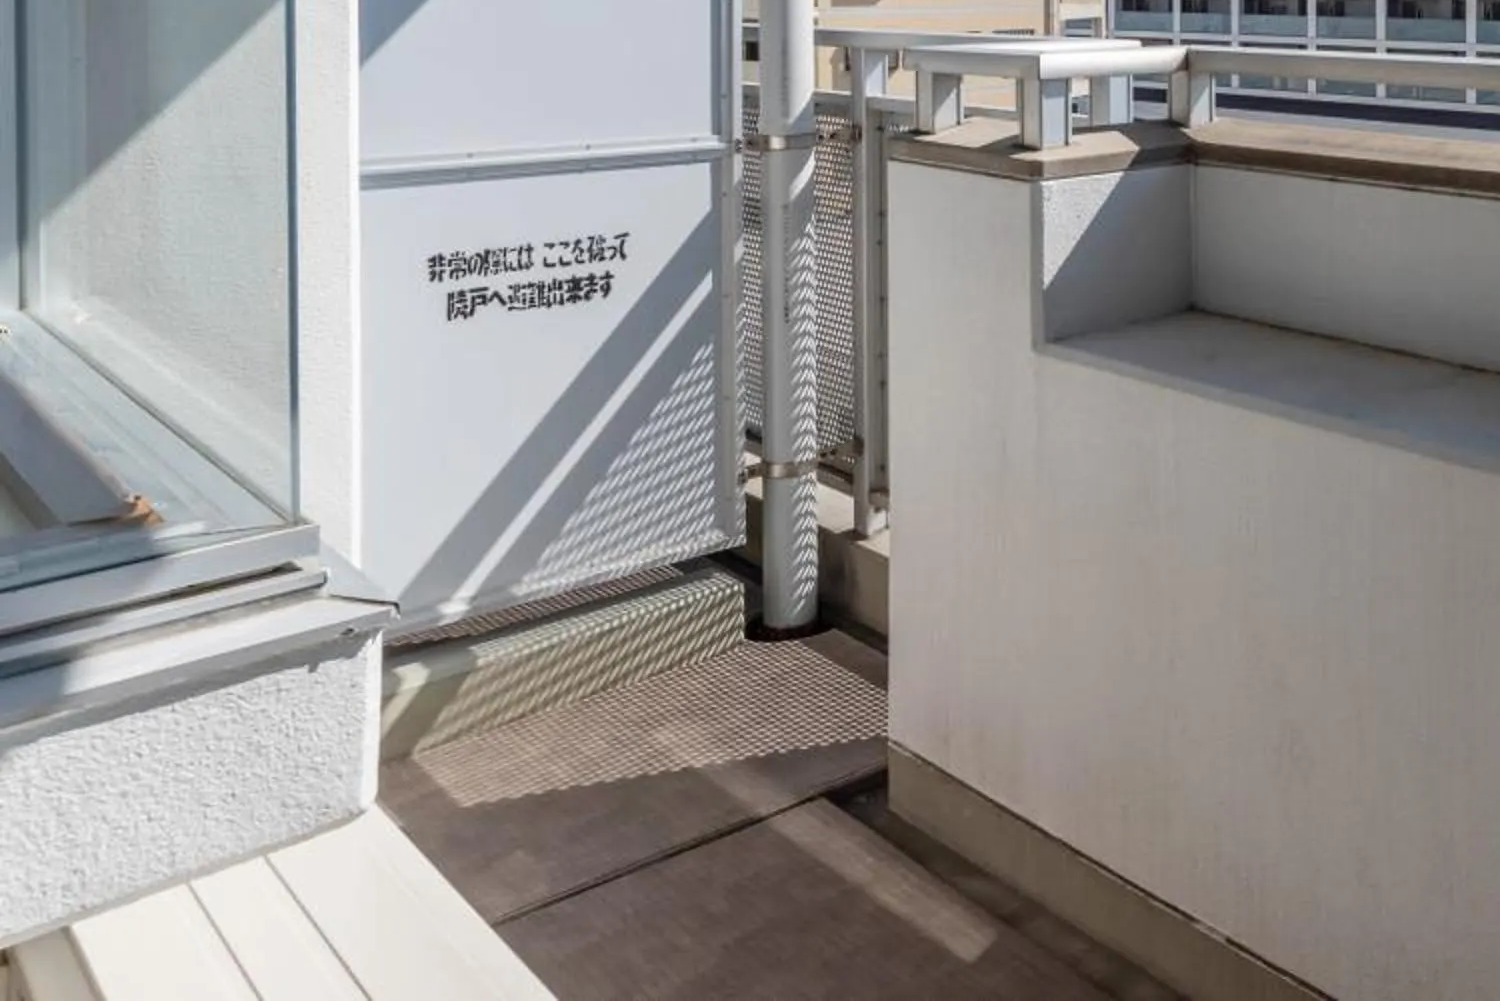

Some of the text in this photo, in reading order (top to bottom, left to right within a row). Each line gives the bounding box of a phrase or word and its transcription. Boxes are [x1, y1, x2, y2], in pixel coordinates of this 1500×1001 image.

[427, 232, 630, 283] 非常の際には ここを破って
